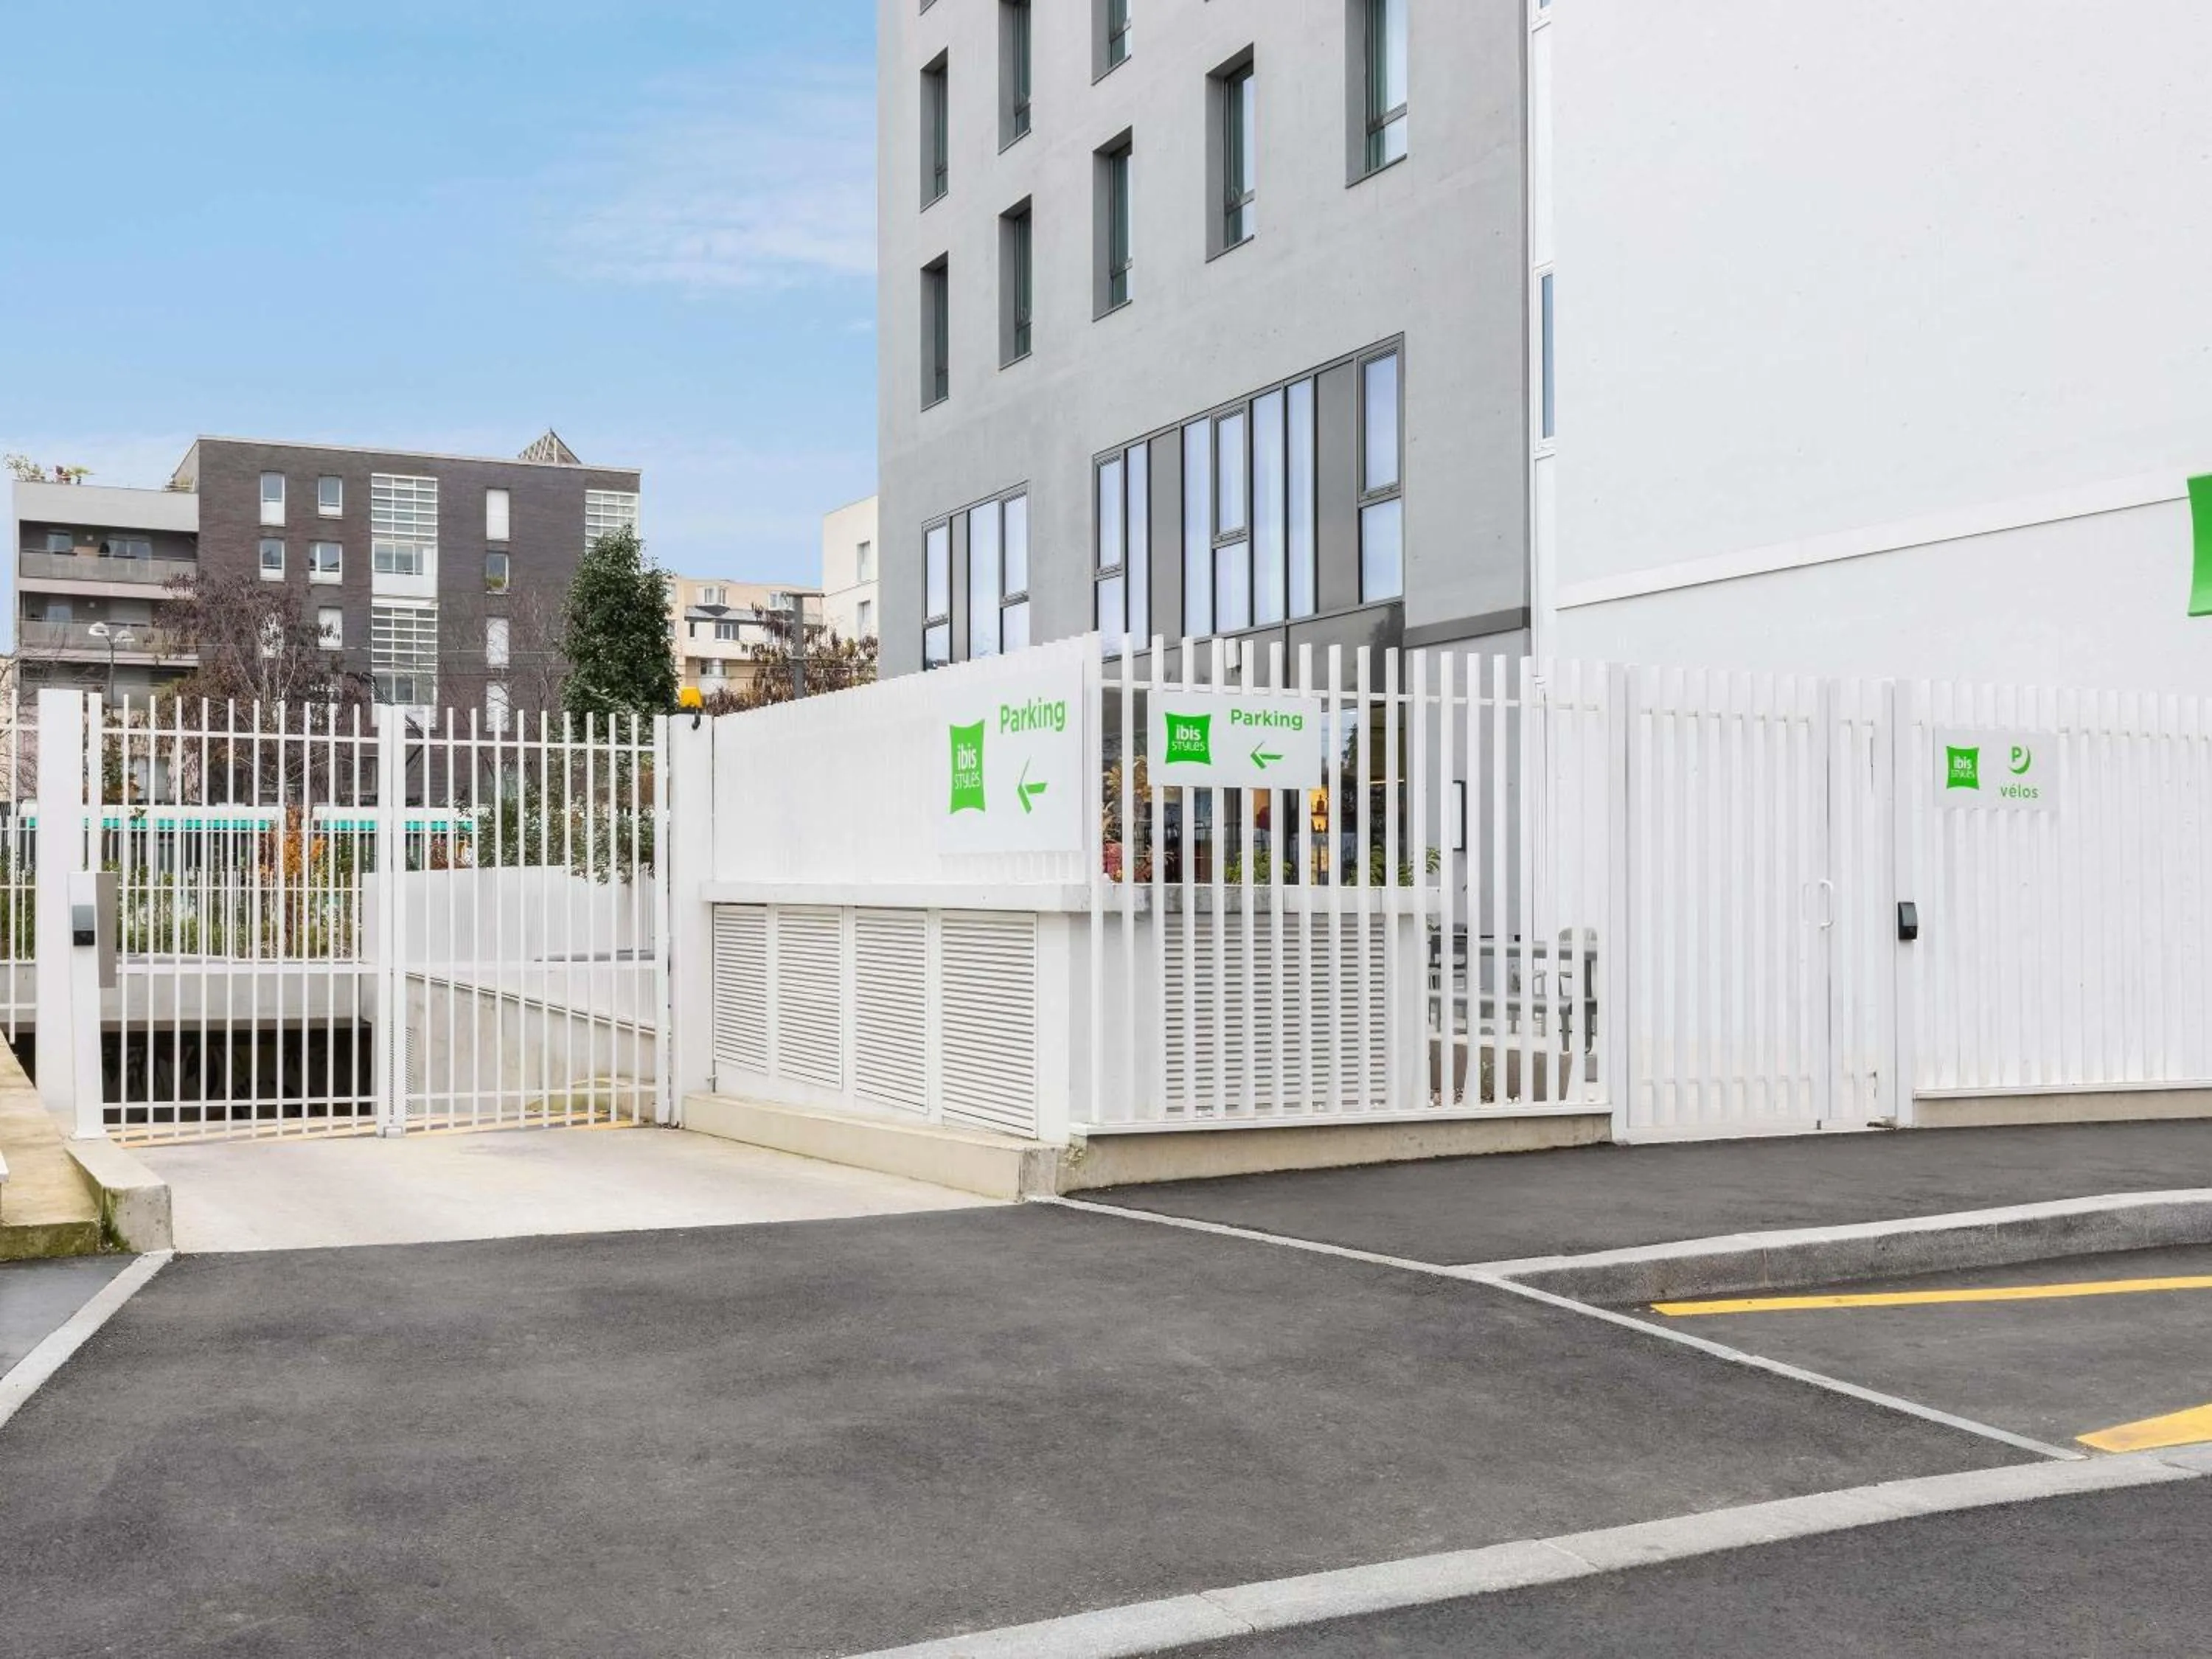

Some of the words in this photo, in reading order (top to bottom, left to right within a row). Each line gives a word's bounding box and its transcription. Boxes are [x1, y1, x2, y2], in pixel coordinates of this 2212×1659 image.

[1001, 697, 1065, 734] Parking
[1230, 709, 1303, 731] Parking
[1175, 723, 1201, 740] ibis
[957, 742, 977, 771] ibis
[1953, 755, 1972, 769] ibis
[2000, 784, 2039, 799] vélos
